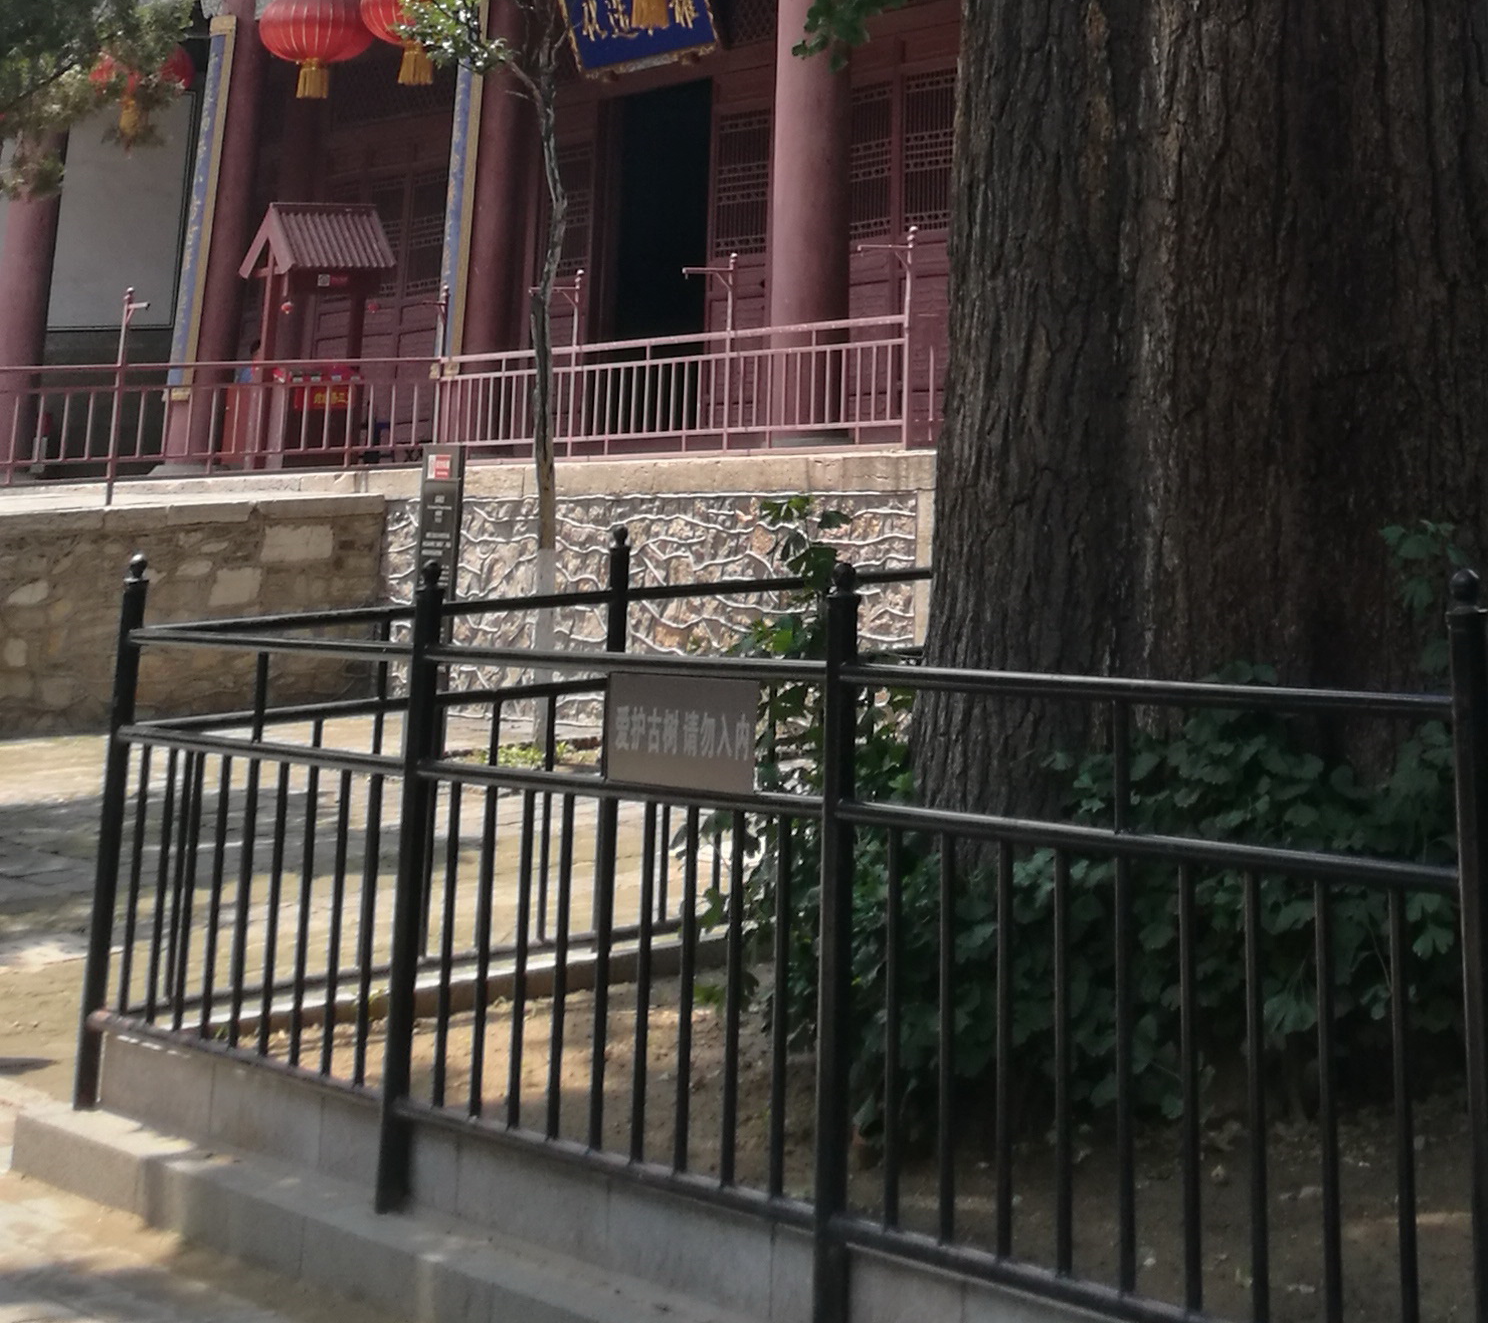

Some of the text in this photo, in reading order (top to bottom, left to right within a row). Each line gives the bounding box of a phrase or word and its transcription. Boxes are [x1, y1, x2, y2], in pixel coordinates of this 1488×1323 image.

[615, 705, 751, 761] 爱护古树 请勿入内
